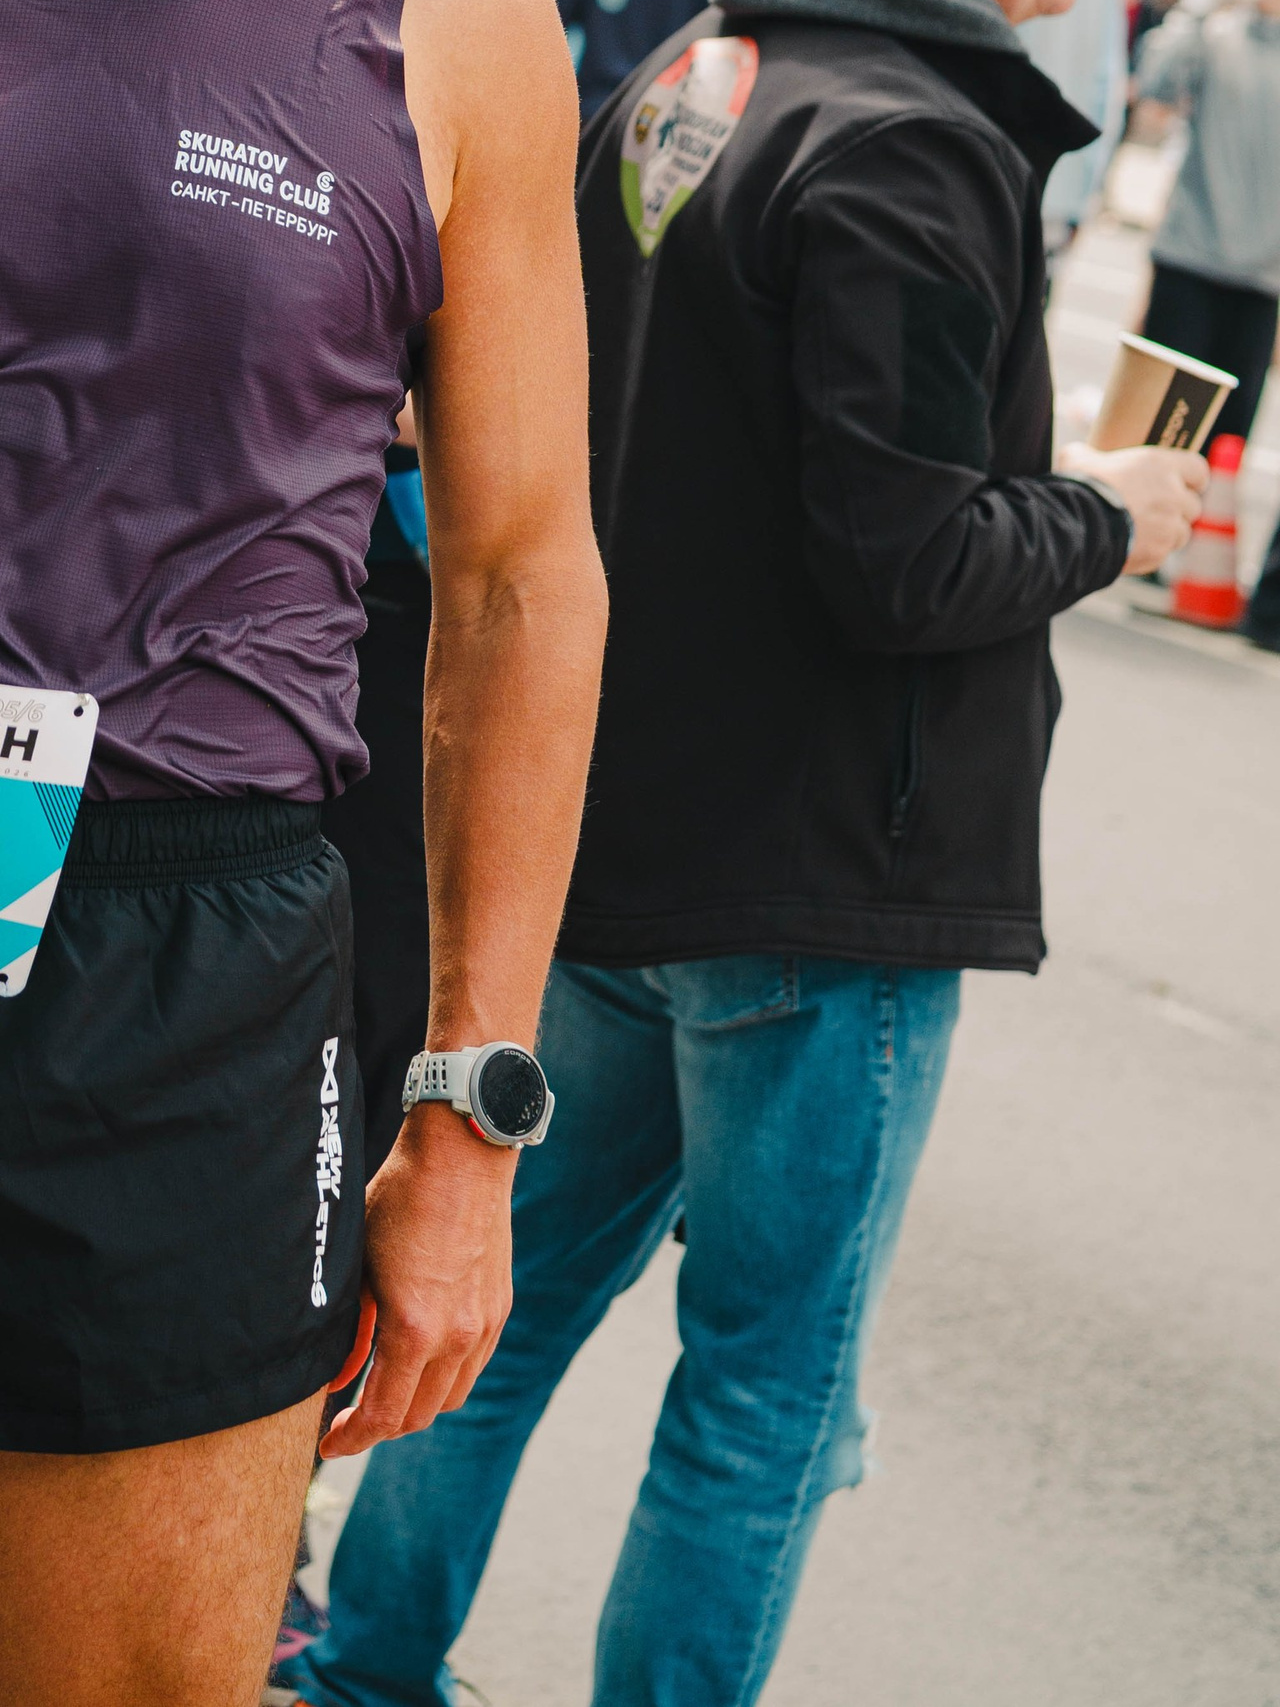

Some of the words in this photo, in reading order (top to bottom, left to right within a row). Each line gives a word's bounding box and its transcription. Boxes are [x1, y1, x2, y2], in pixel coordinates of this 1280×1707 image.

[174, 150, 274, 195] RUNNING
[279, 180, 331, 216] CLUB
[178, 129, 289, 175] SKURATOV
[170, 179, 338, 245] САНКТ-ПЕТЕРБУРГ
